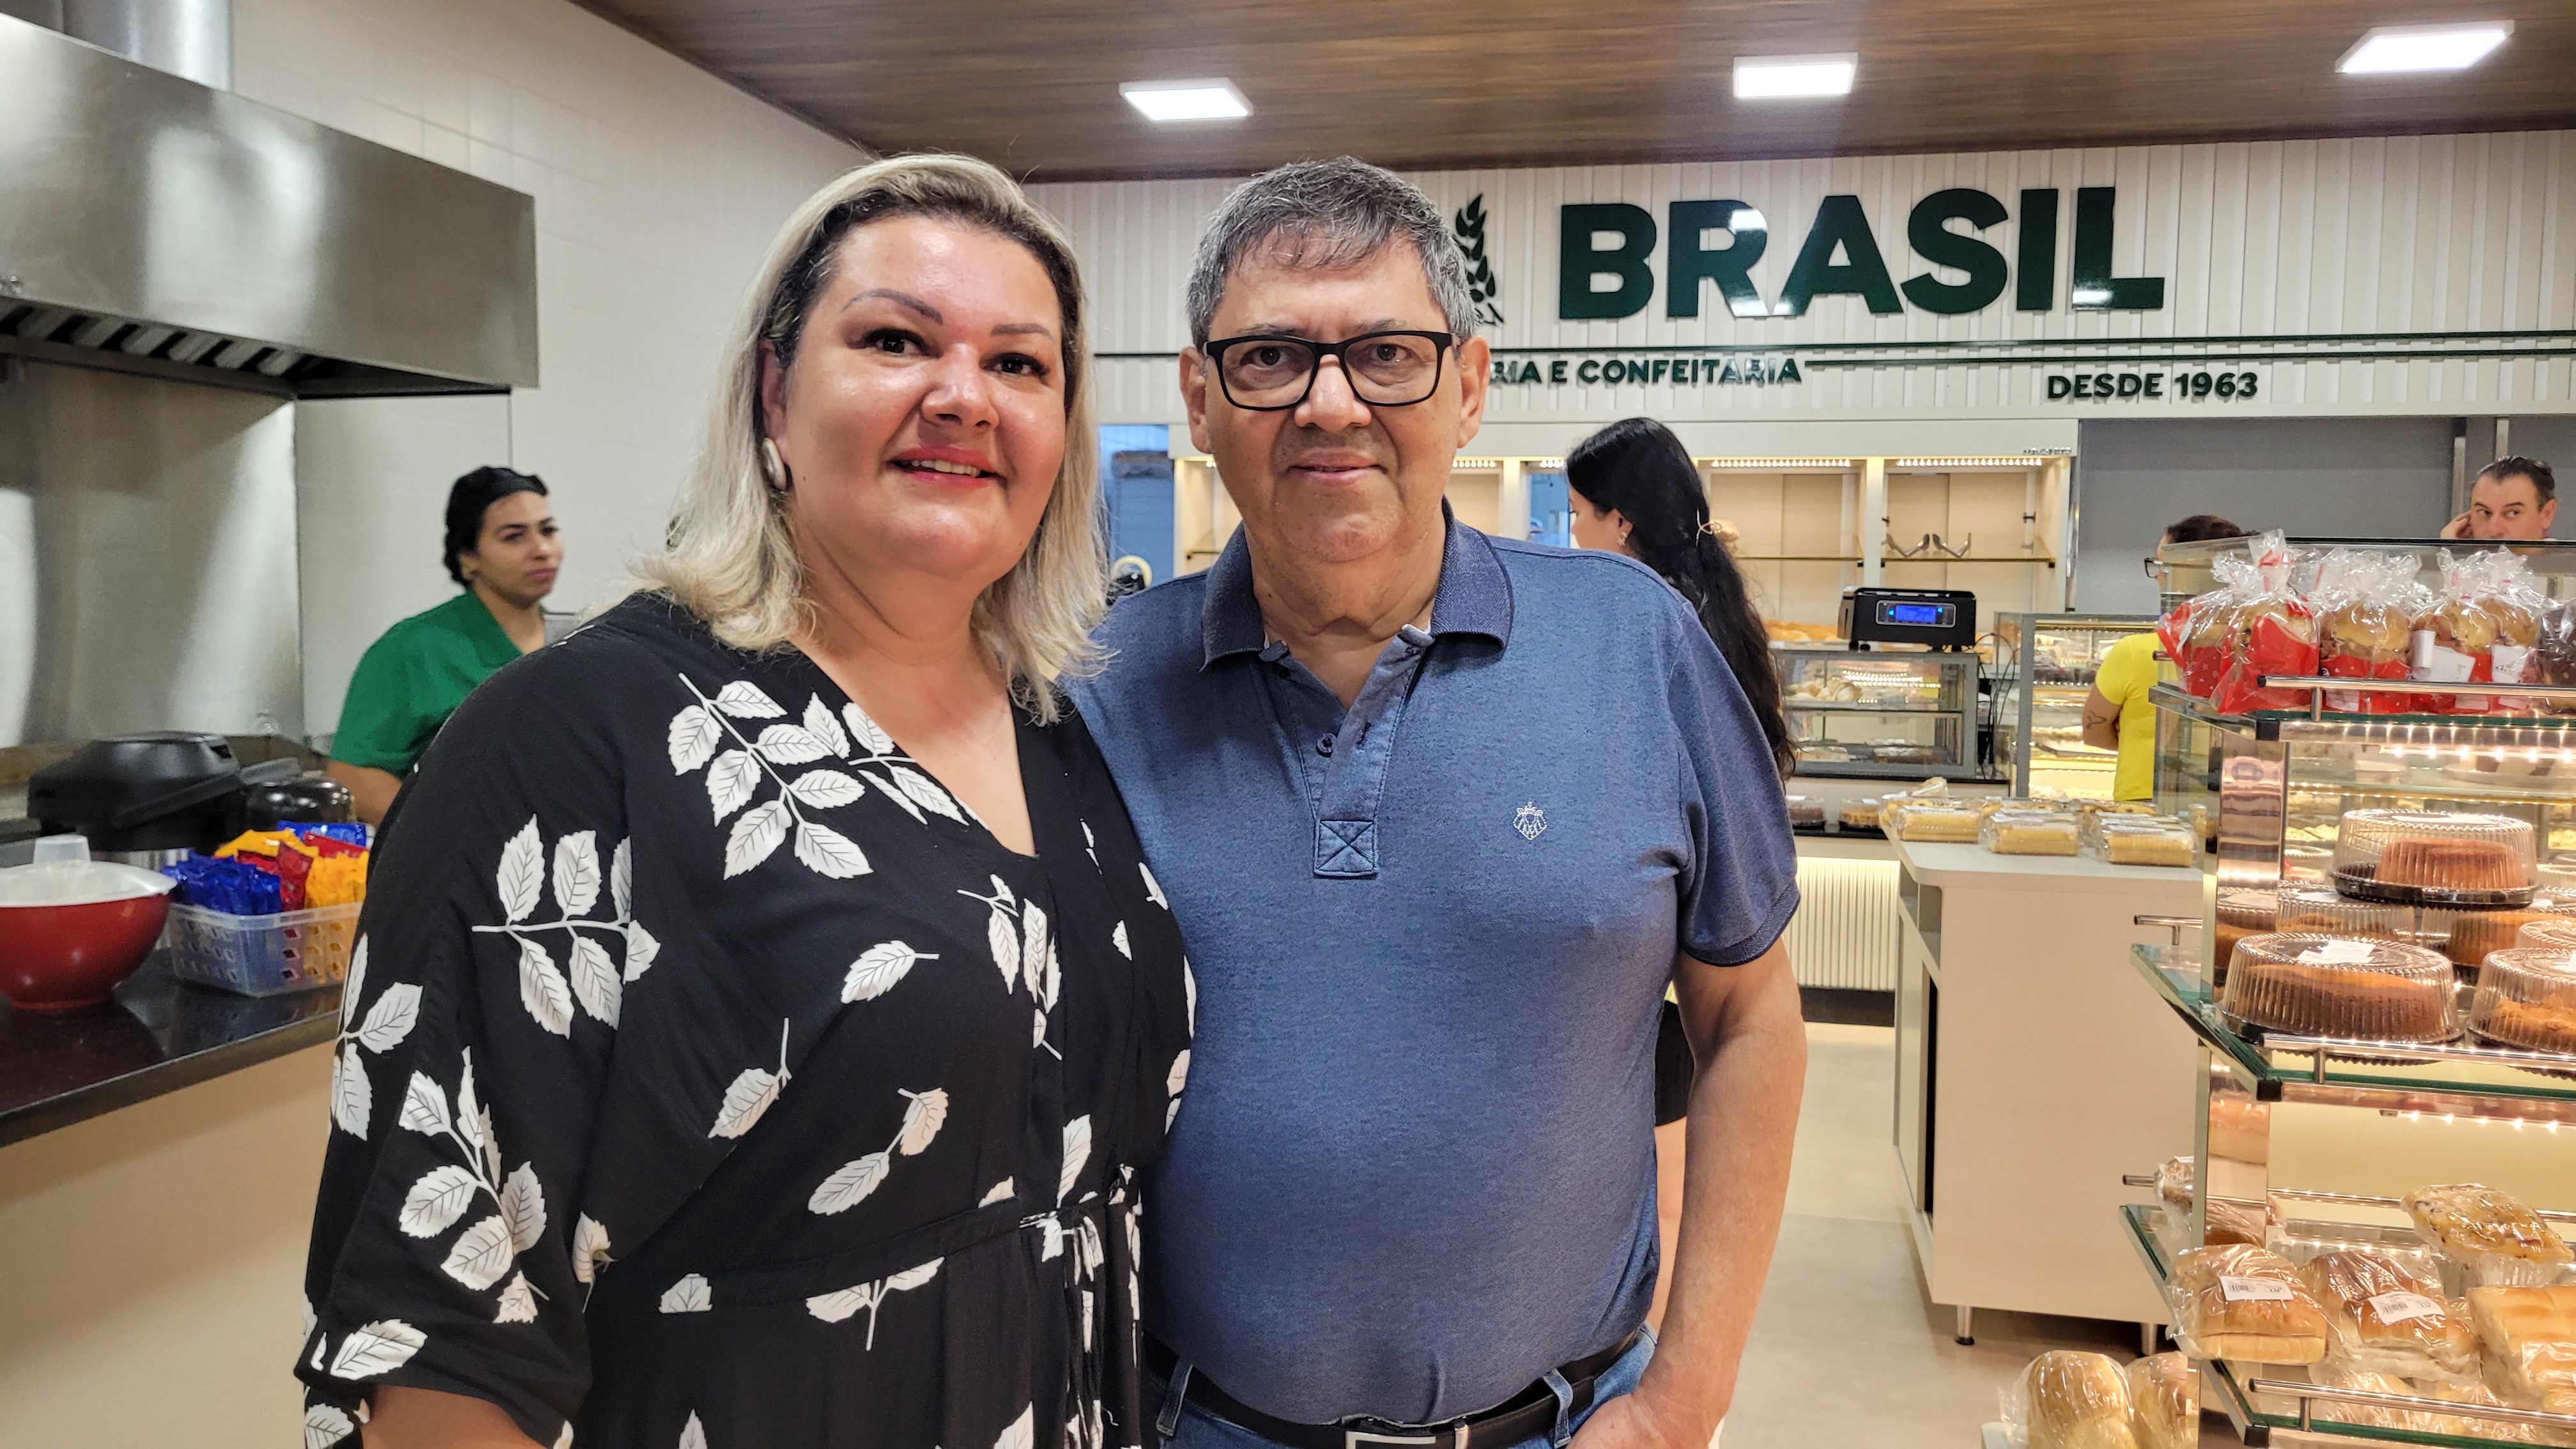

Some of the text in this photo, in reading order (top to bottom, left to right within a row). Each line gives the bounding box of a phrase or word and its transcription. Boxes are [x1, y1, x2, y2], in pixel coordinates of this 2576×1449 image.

[1560, 186, 2165, 319] BRASIL
[1490, 358, 1802, 384] RIA E CONFEITARIA
[2048, 372, 2258, 399] DESDE 1963
